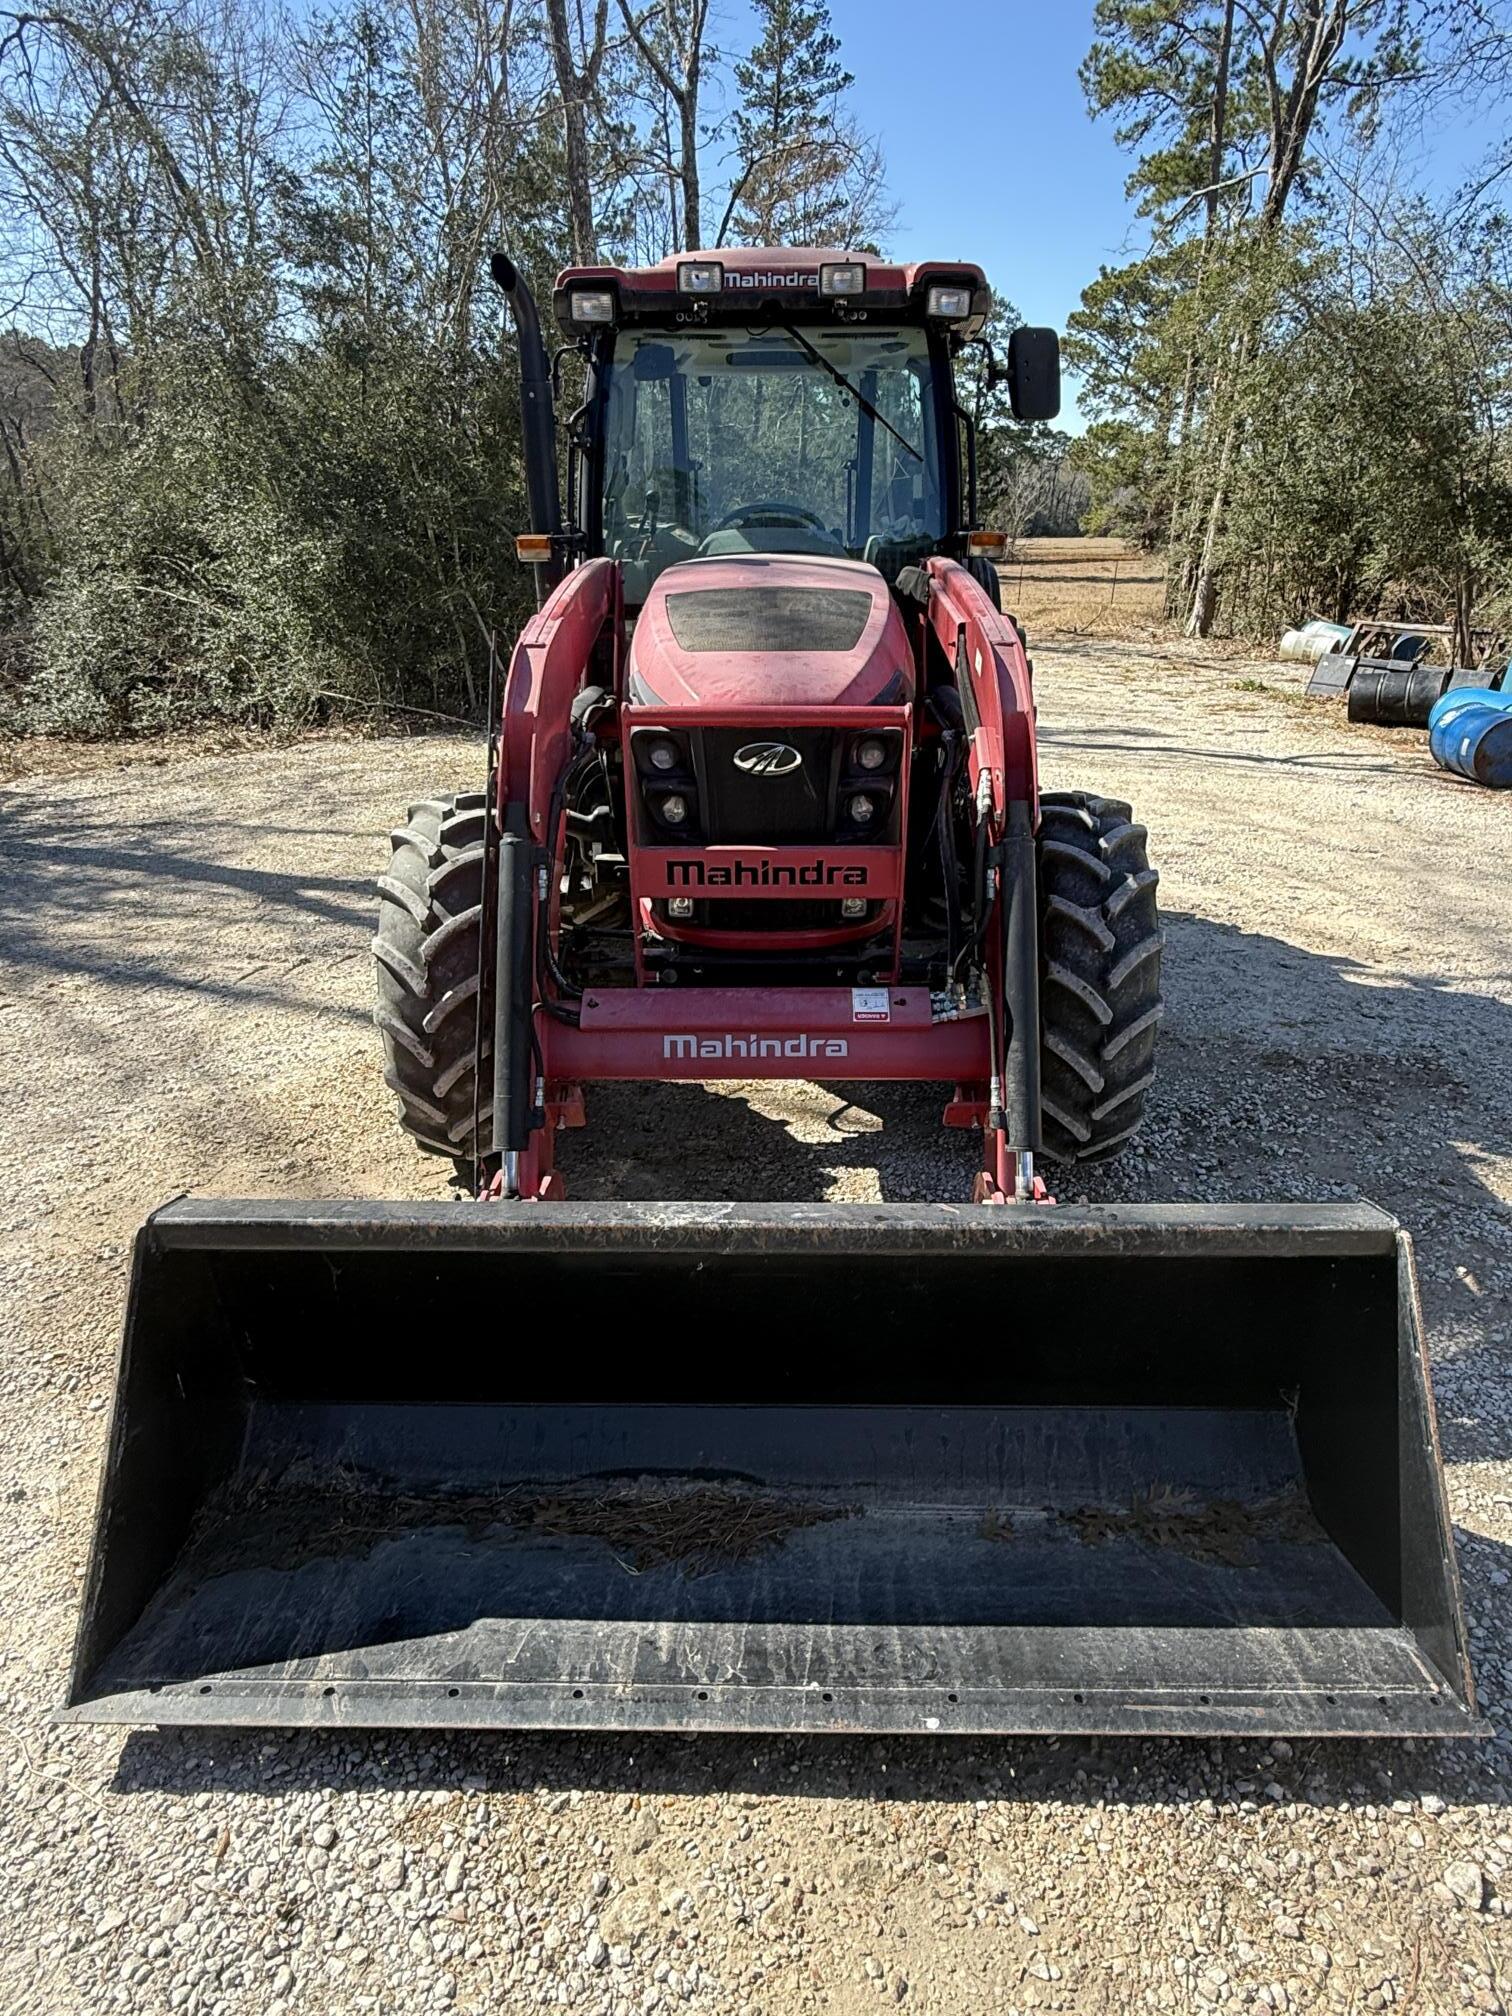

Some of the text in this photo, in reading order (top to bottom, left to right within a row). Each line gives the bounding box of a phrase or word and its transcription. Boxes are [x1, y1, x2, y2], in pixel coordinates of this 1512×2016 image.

[724, 271, 819, 287] Mahindra
[666, 860, 868, 885] Mahindra
[663, 1034, 848, 1058] Mahindra
